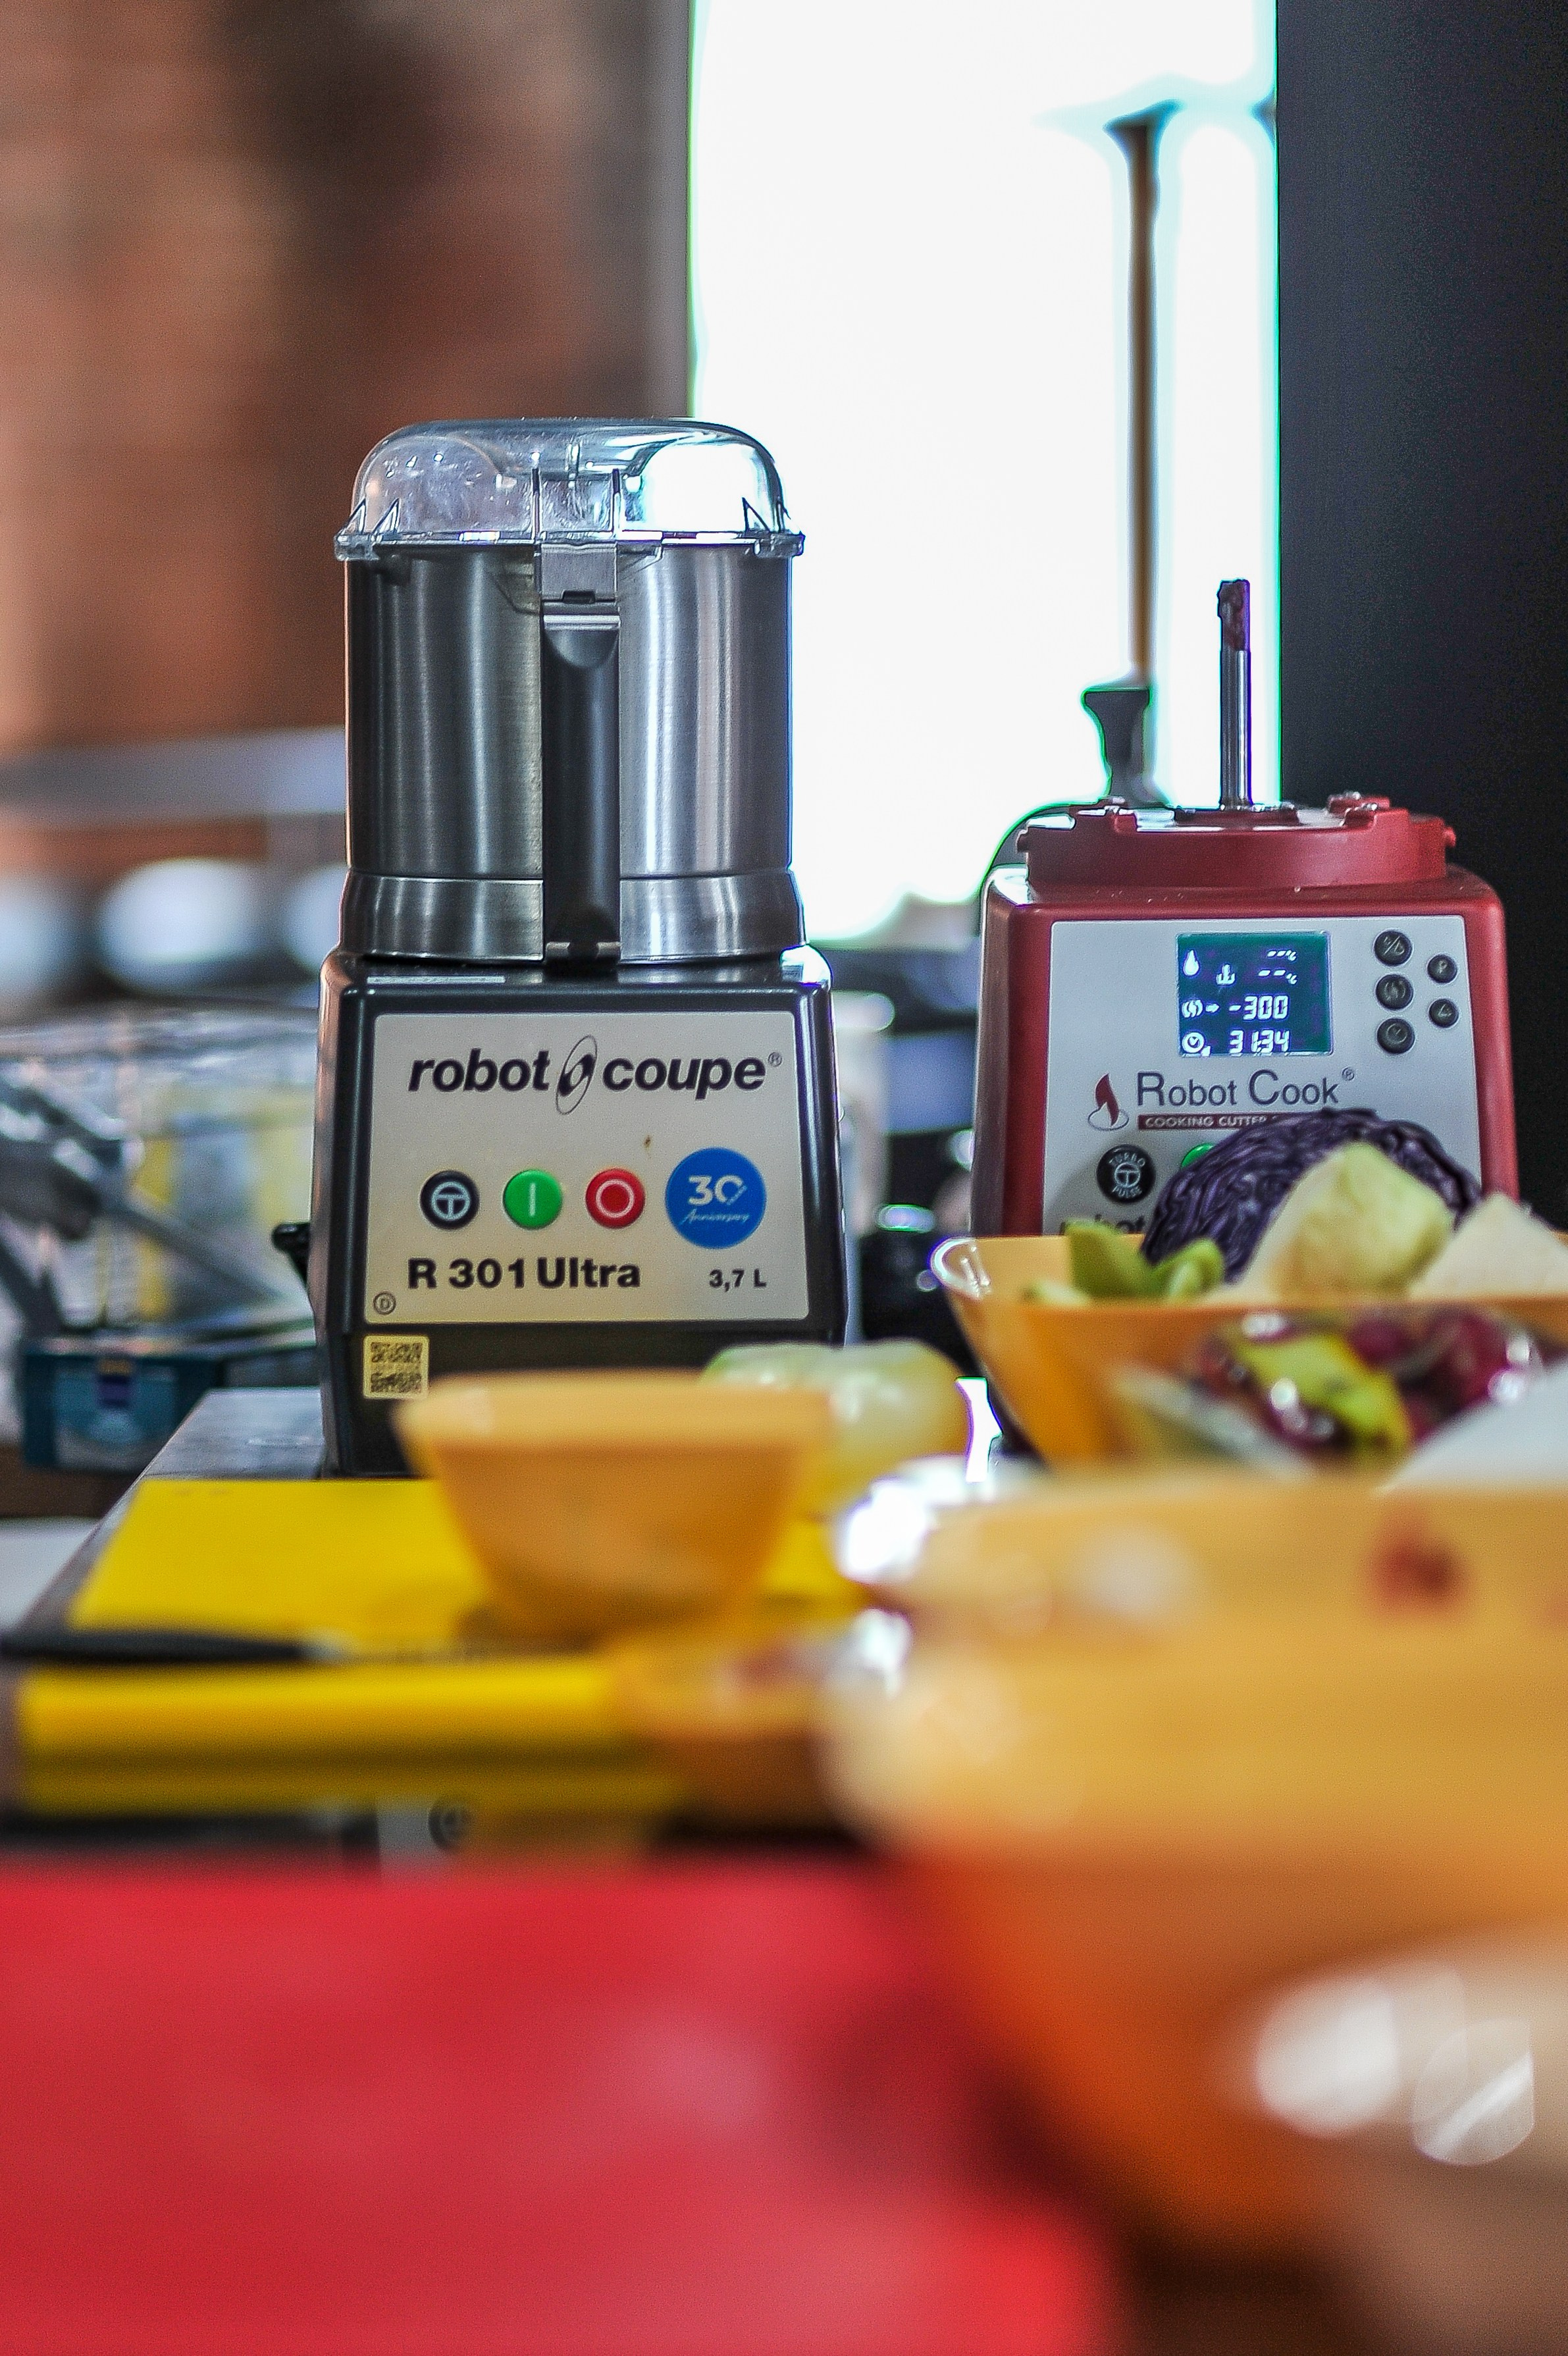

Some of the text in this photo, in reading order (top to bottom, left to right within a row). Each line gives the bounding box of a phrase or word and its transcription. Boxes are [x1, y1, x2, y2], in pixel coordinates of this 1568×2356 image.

[407, 1048, 551, 1093] robot
[1137, 1071, 1238, 1107] Robot
[1145, 1116, 1214, 1128] COOKING
[407, 1256, 641, 1289] R 301 Ultra
[709, 1268, 767, 1292] 3,7 L
